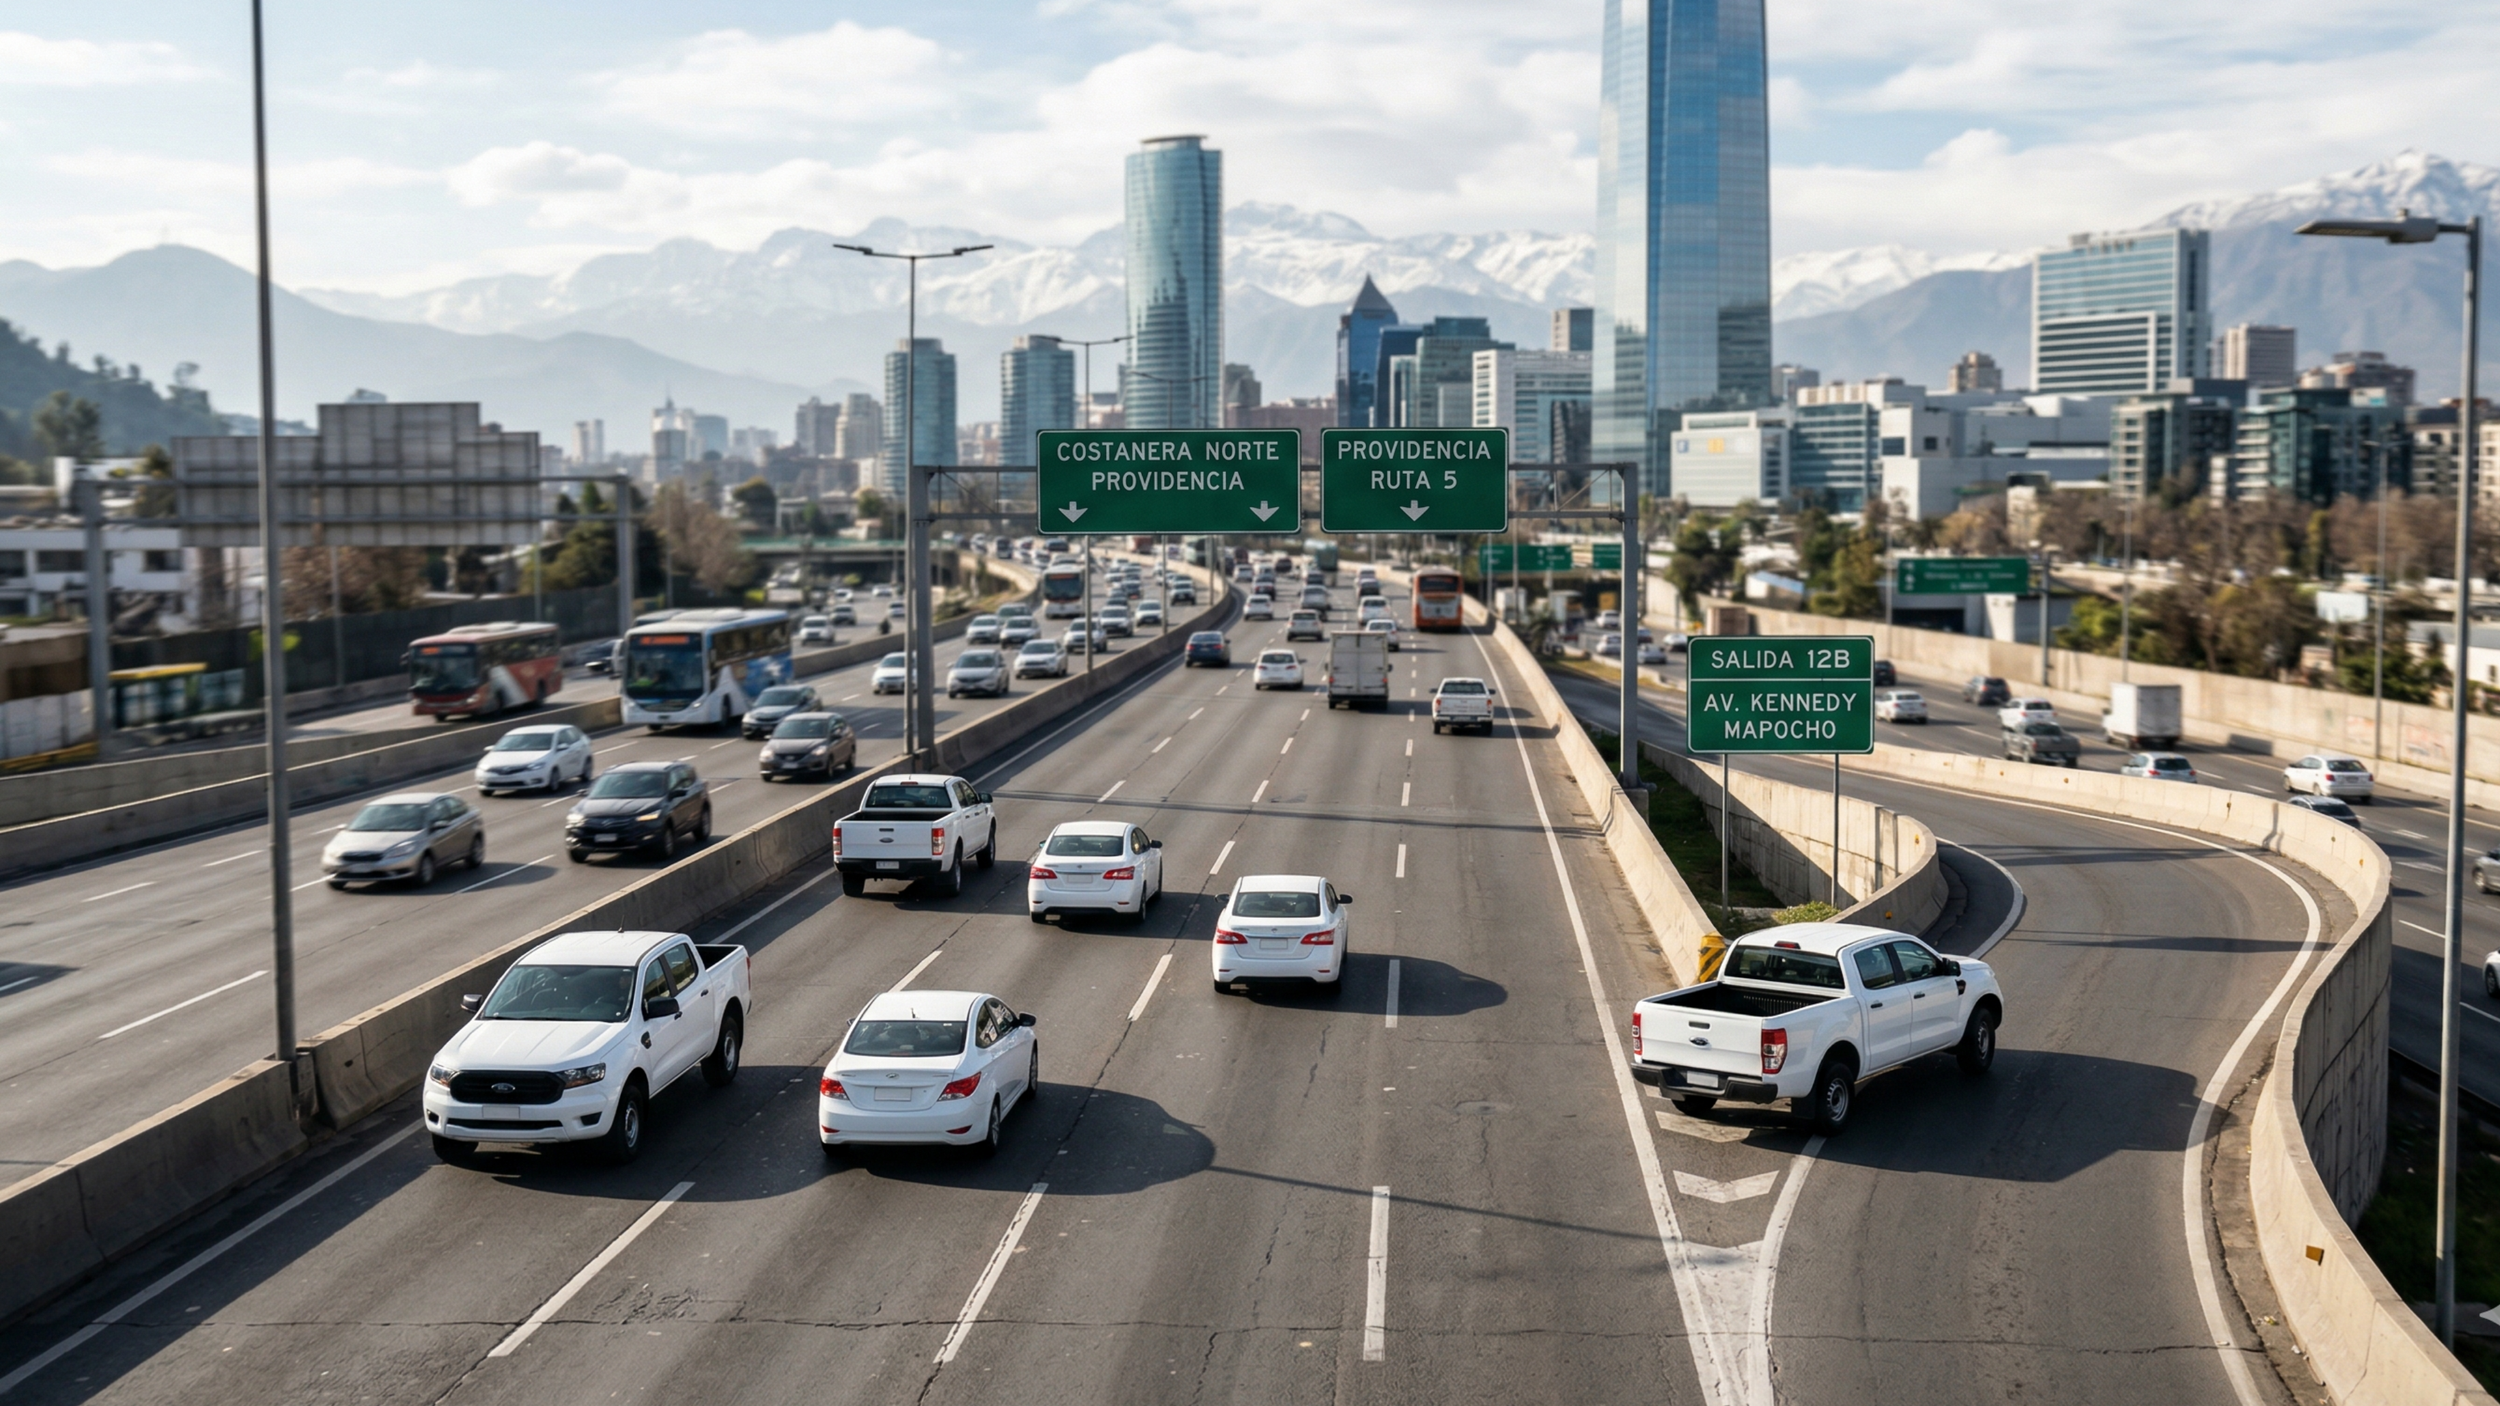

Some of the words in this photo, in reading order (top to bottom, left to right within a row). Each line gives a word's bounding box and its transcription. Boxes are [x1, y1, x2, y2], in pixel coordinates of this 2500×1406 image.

[1057, 441, 1193, 462] COSTANERA
[1205, 441, 1280, 461] NORTE
[1338, 440, 1491, 460] PROVIDENCIA
[1092, 471, 1245, 491] PROVIDENCIA
[1370, 470, 1431, 490] RUTA
[1444, 470, 1457, 490] 5
[1711, 650, 1794, 669] SALIDA
[1807, 649, 1850, 669] 12B
[1703, 693, 1739, 712] AV.
[1751, 693, 1857, 712] KENNEDY
[1724, 720, 1837, 740] MAPOCHO
